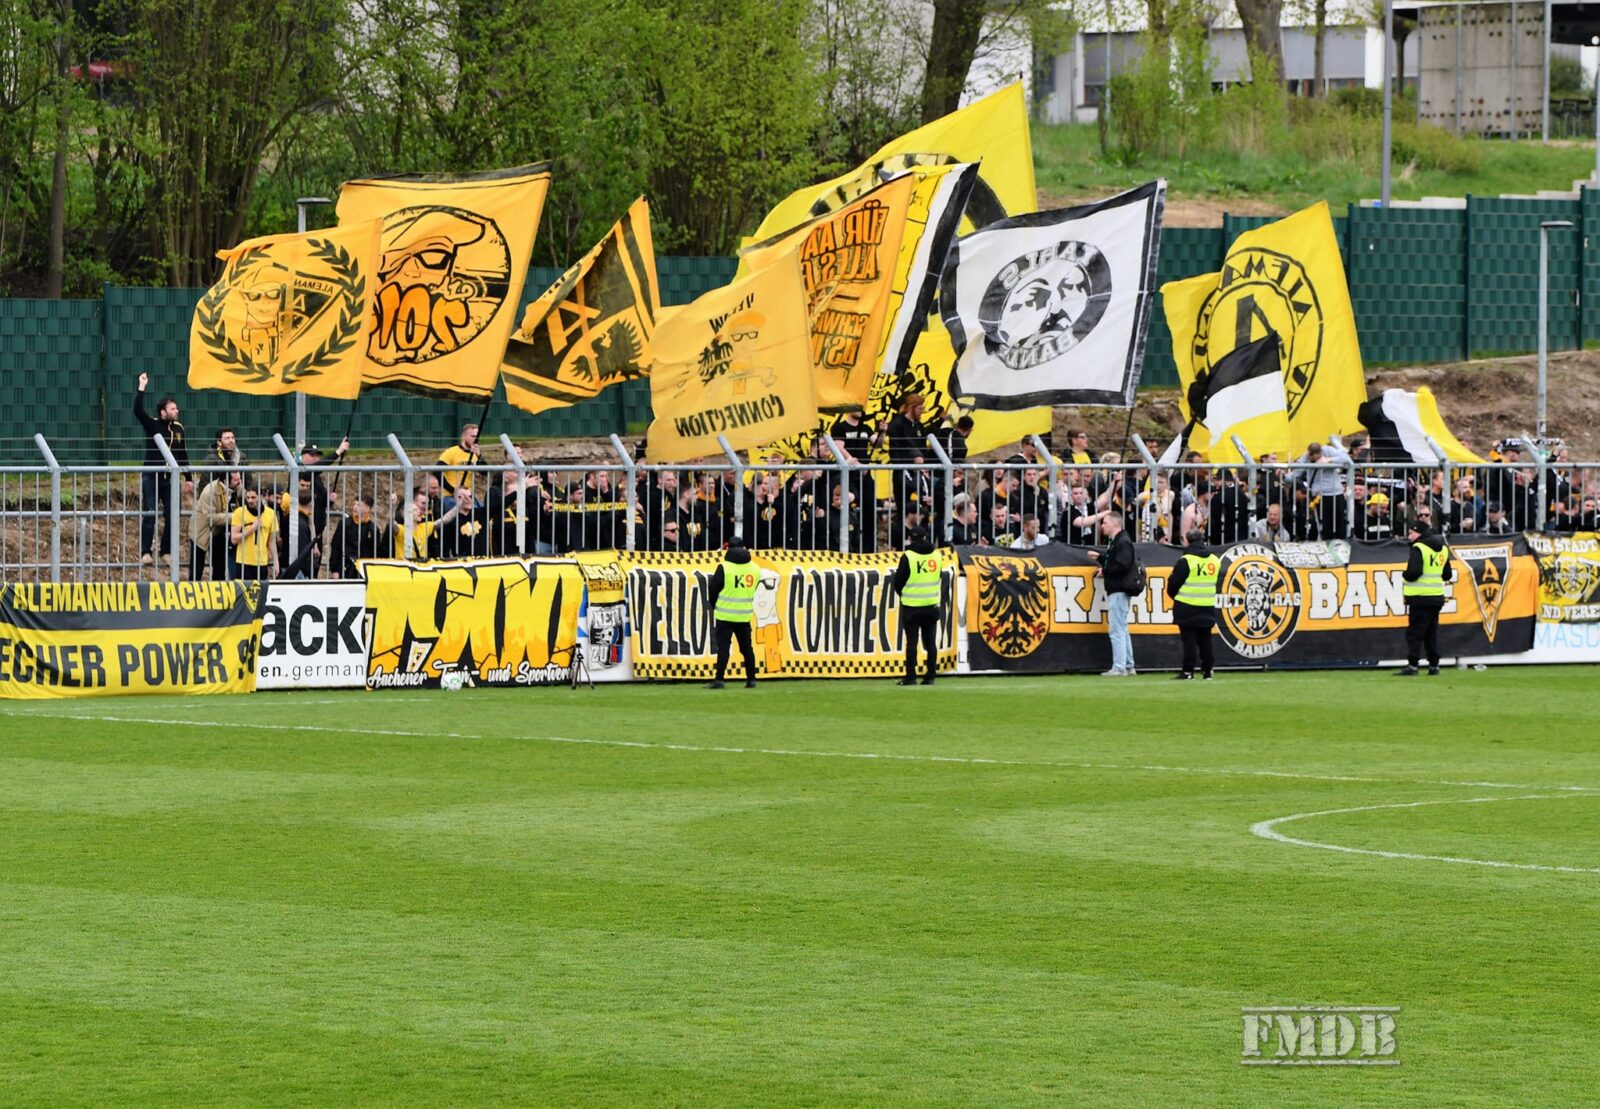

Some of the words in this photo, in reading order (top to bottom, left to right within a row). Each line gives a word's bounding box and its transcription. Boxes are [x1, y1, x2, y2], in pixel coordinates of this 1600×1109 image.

[1555, 538, 1598, 553] STADT
[916, 559, 937, 574] K9
[1430, 553, 1444, 567] K9
[1197, 562, 1216, 576] K9
[734, 574, 754, 589] K9
[13, 581, 141, 612] ALEMANNIA
[149, 580, 237, 612] AACHEN
[1235, 639, 1284, 658] BANDE
[117, 642, 228, 687] POWER
[367, 664, 428, 689] Aachener
[488, 662, 511, 682] und
